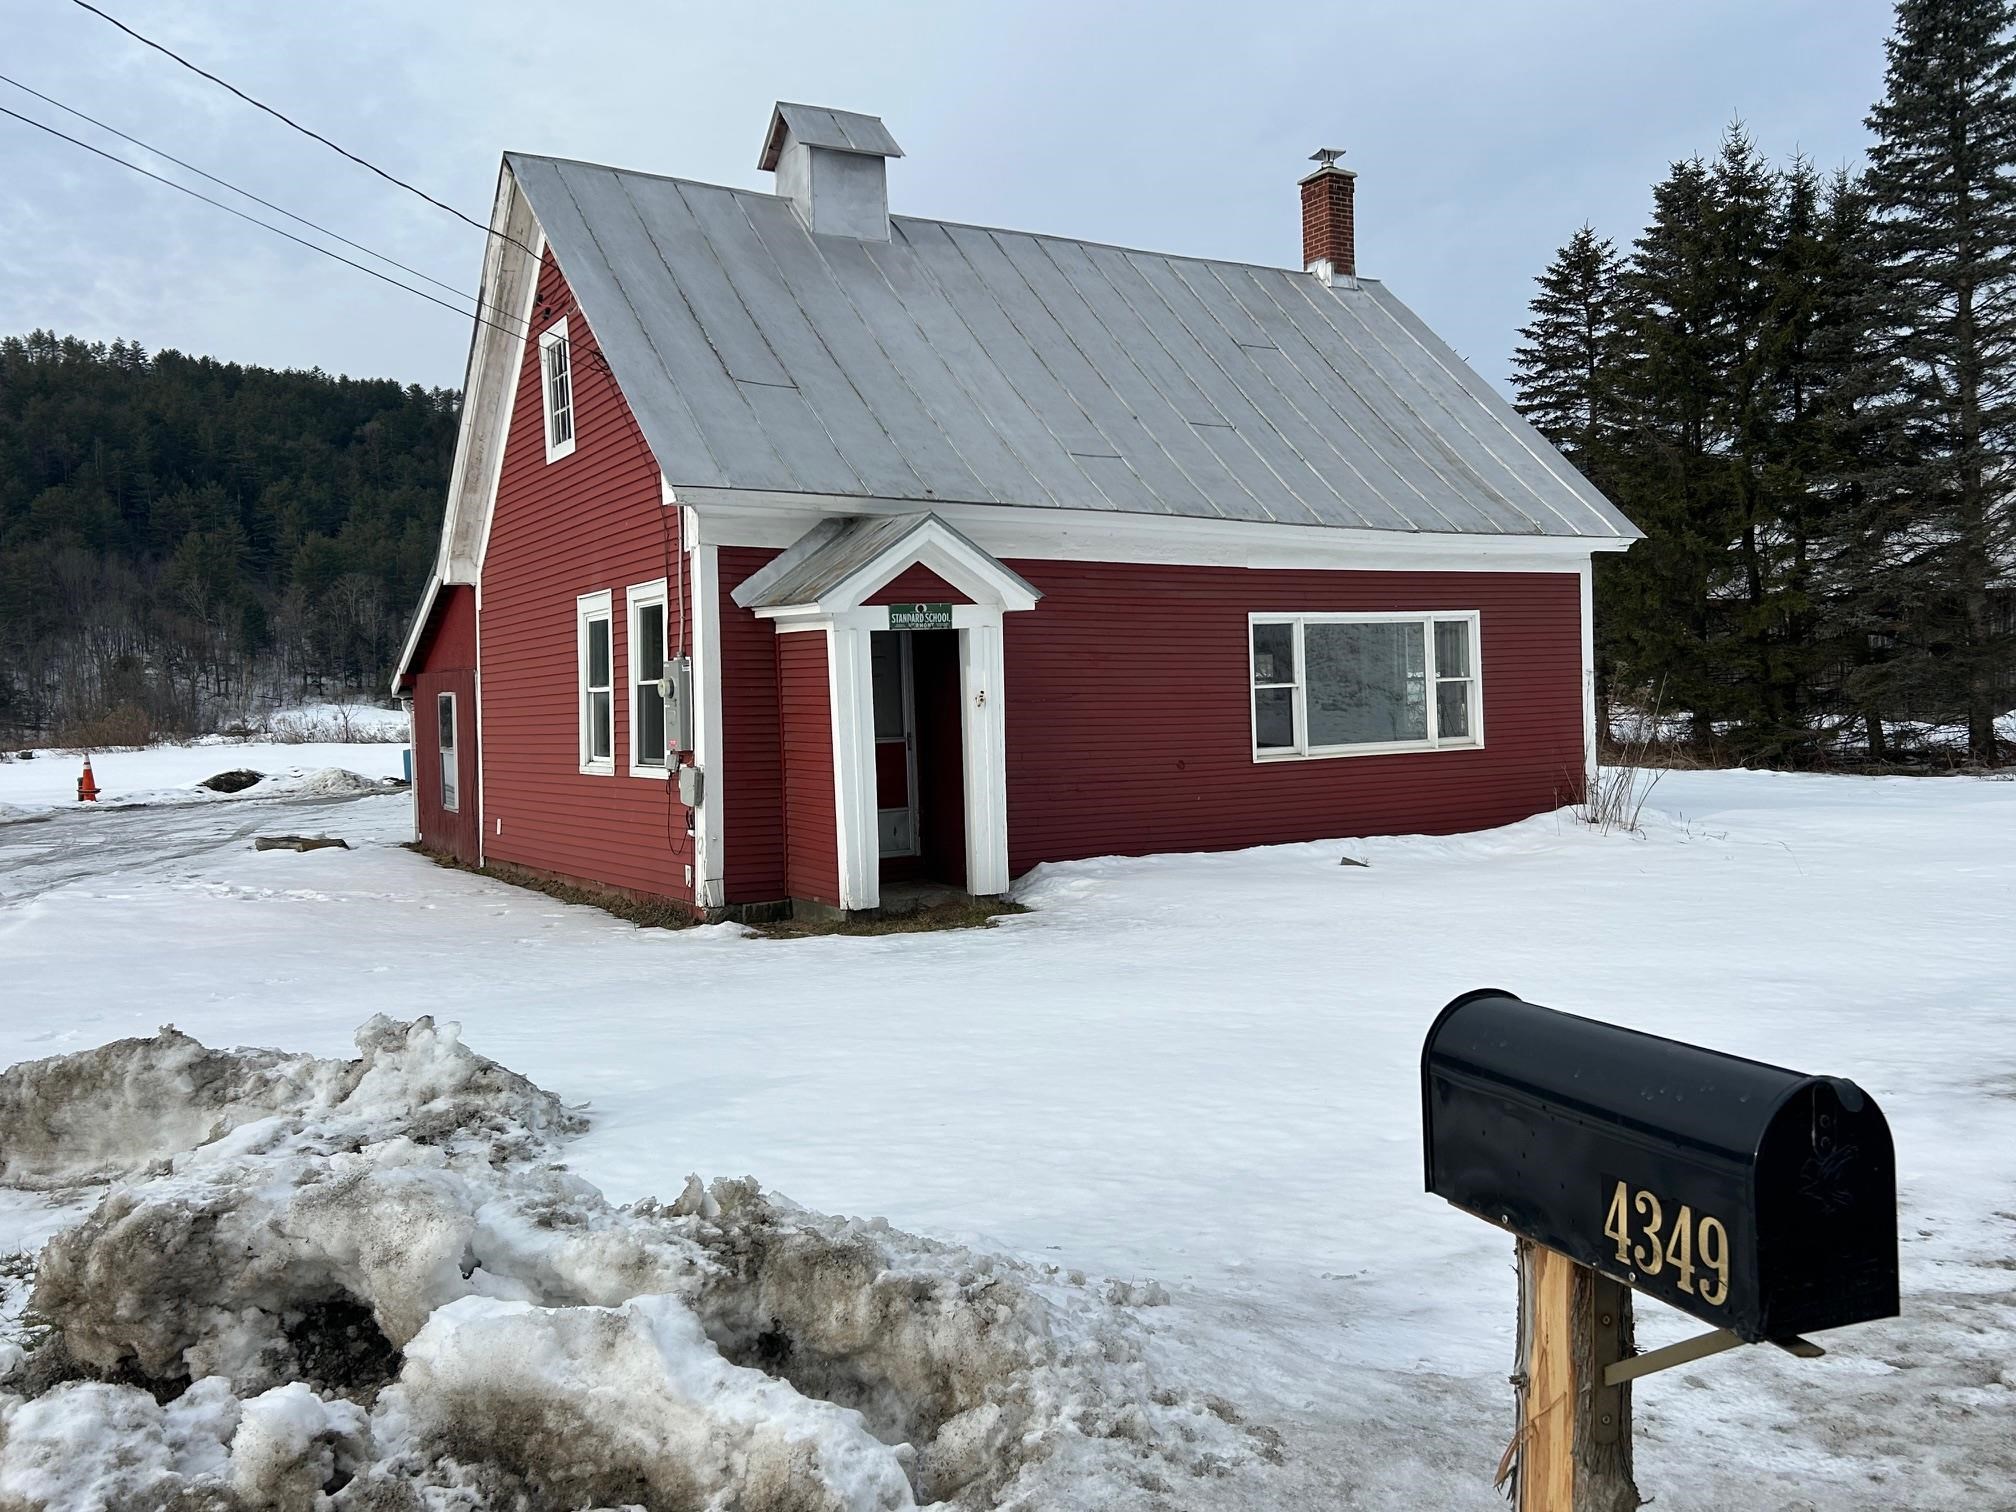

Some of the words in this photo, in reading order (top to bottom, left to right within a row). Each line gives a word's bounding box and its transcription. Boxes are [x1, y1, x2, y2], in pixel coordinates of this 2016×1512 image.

[891, 613, 924, 623] STANDARD
[925, 612, 951, 622] SCHOOL
[1604, 1180, 1729, 1306] 4349
